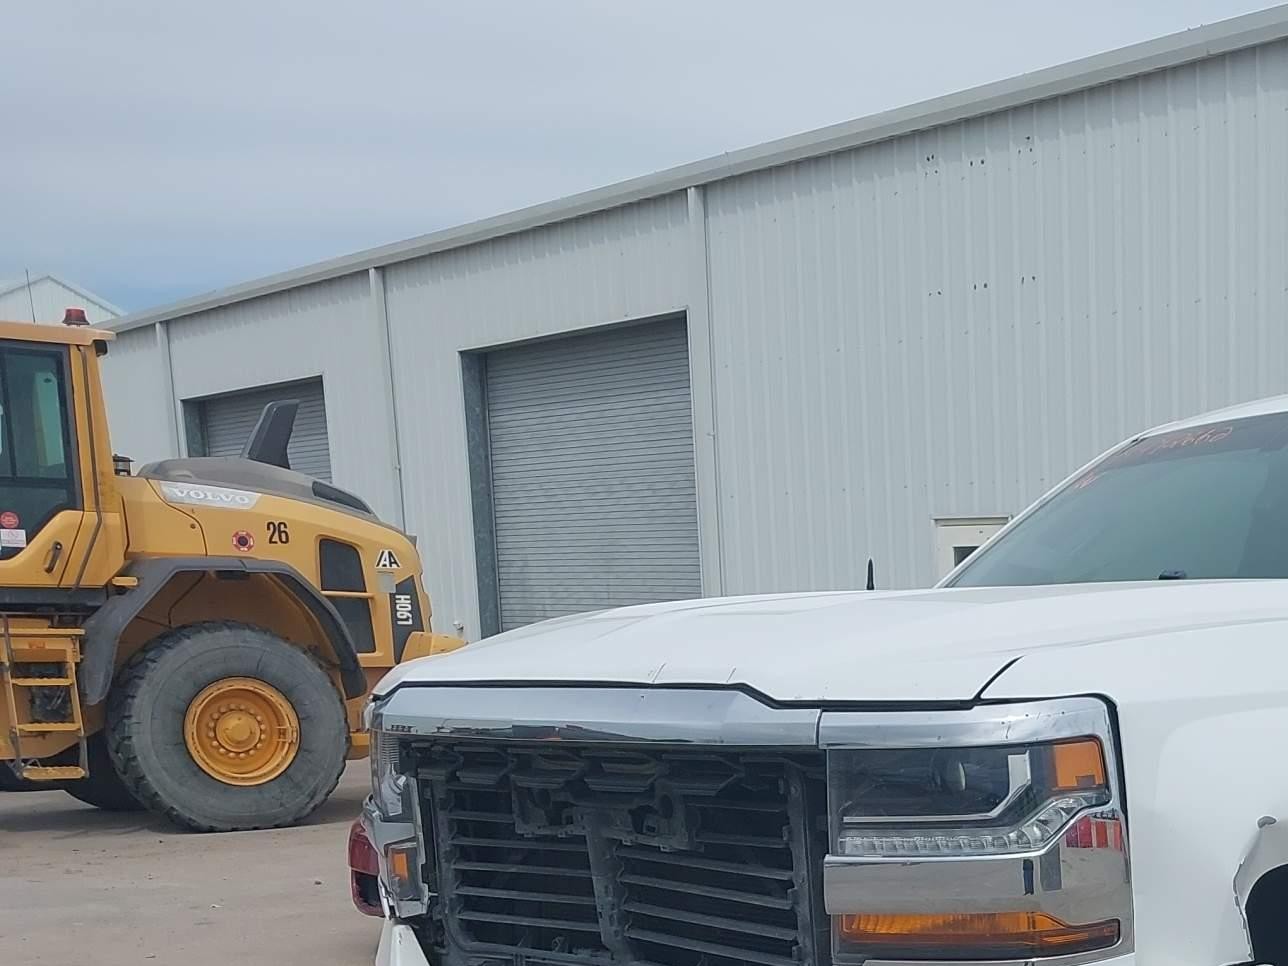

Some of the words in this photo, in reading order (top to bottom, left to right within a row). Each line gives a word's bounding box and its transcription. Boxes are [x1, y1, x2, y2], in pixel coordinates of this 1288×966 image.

[168, 486, 250, 504] VOLVO
[266, 521, 290, 544] 26
[395, 594, 413, 625] L90H
